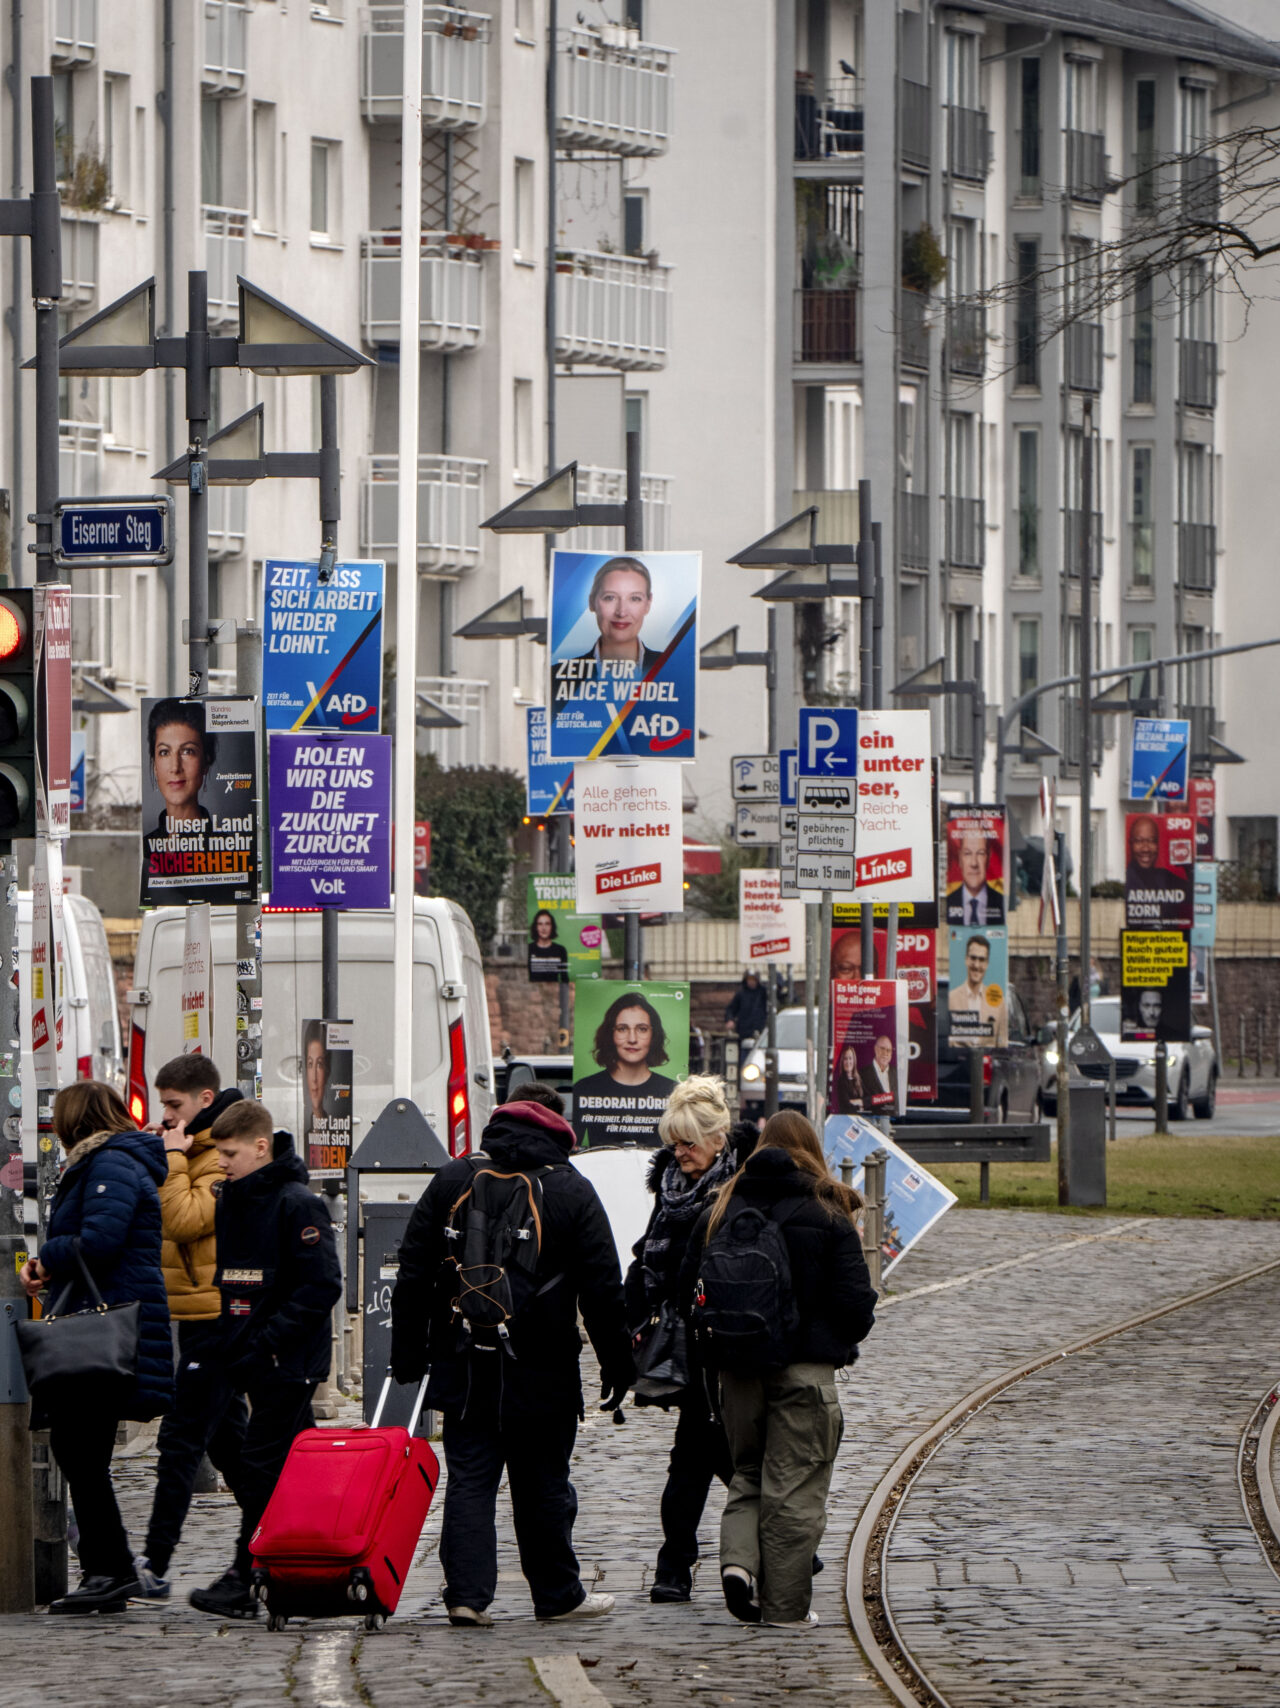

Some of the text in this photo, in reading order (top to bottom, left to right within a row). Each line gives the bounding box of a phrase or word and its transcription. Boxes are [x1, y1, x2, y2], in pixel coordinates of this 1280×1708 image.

[72, 514, 152, 551] Eiserner Steg
[270, 567, 312, 589] ZEIT,
[270, 589, 377, 611] SICH ARBEIT
[271, 612, 338, 632] WIEDER
[269, 634, 330, 654] LOHNT.
[555, 658, 636, 679] ZEIT FÜR
[555, 681, 679, 702] ALICE WEIDEL
[326, 693, 367, 713] AfD
[556, 710, 584, 720] ZEIT FÜR
[212, 719, 249, 727] Wagenknecht
[556, 720, 603, 728] DEUTSCHLAND.
[630, 713, 680, 737] AfD
[808, 716, 840, 768] P
[859, 730, 894, 748] ein
[294, 747, 365, 766] HOLEN
[863, 755, 925, 772] unter
[234, 780, 252, 789] BSW
[286, 769, 374, 788] WIR UNS
[583, 785, 657, 801] Alle gehen
[1160, 782, 1180, 791] AfD
[311, 791, 346, 810] DIE
[583, 798, 671, 812] nach rechts.
[863, 802, 909, 814] Reiche
[165, 813, 253, 834] Unser Land
[279, 812, 379, 832] ZUKUNFT
[803, 823, 850, 836] gebühren-
[859, 819, 902, 831] Yacht.
[1167, 818, 1191, 830] SPD
[583, 823, 670, 838] Wir nicht!
[148, 832, 253, 852] verdient mehr
[284, 831, 373, 854] ZURÜCK
[808, 835, 844, 848] pflichtig
[148, 851, 254, 873] SICHERHEIT.
[303, 858, 337, 866] LÖSUNGEN
[337, 858, 350, 866] FÜR
[323, 864, 341, 872] GRÜN
[861, 858, 907, 881] Linke
[601, 869, 657, 890] Die Linke
[800, 866, 851, 879] max 15 min
[310, 878, 347, 894] Volt
[744, 879, 758, 888] Ist
[744, 891, 775, 900] Rente
[1128, 889, 1185, 903] ARMAND
[744, 902, 783, 914] niedrig.
[836, 905, 860, 913] Dann
[1128, 904, 1160, 917] ZORN
[896, 934, 930, 952] SPD
[1126, 935, 1180, 945] Migration:
[1126, 945, 1184, 954] Auch guter
[579, 1096, 636, 1109] DEBORAH
[328, 1114, 350, 1131] Land
[582, 1114, 634, 1123] FÜR FREIHEIT. FÜR
[606, 1124, 654, 1133] FÜR FRANKFURT.
[331, 1130, 350, 1145] sich
